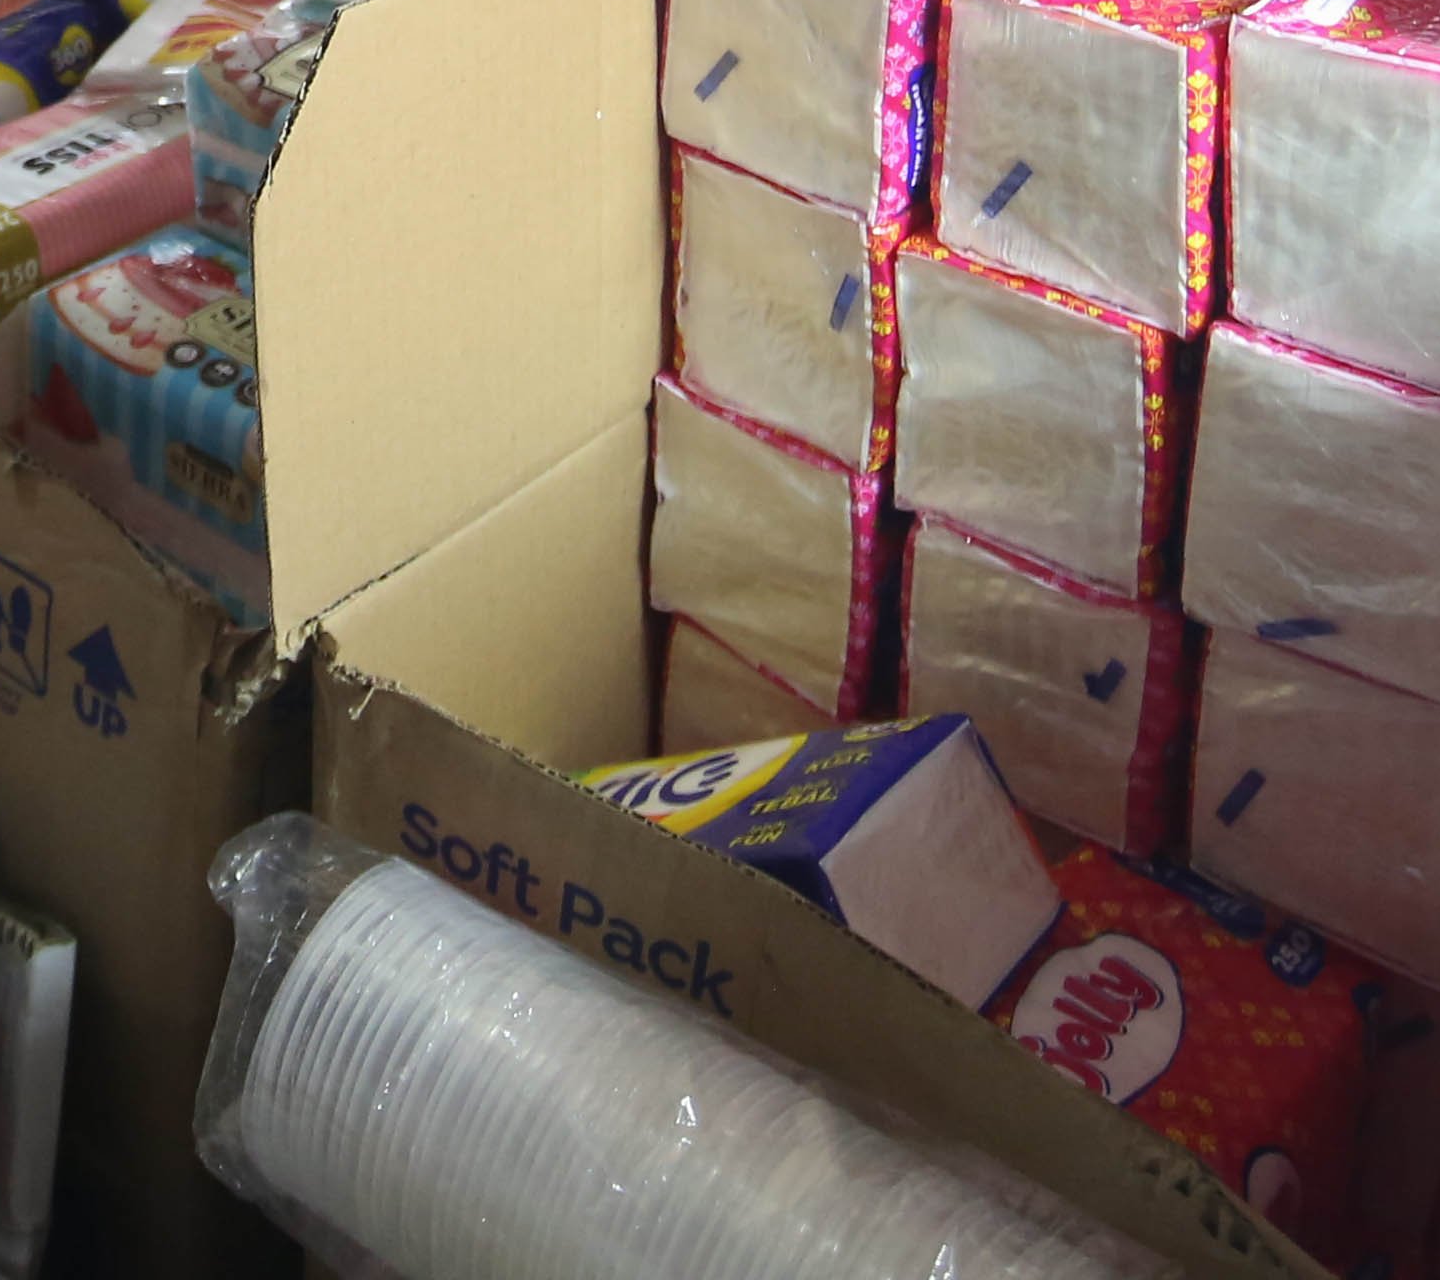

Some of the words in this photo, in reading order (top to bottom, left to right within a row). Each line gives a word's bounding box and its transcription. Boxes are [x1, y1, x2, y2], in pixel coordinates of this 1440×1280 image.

[24, 134, 117, 180] TISS
[728, 828, 787, 848] FUN
[399, 802, 540, 917] Soft
[558, 881, 734, 1020] Pack
